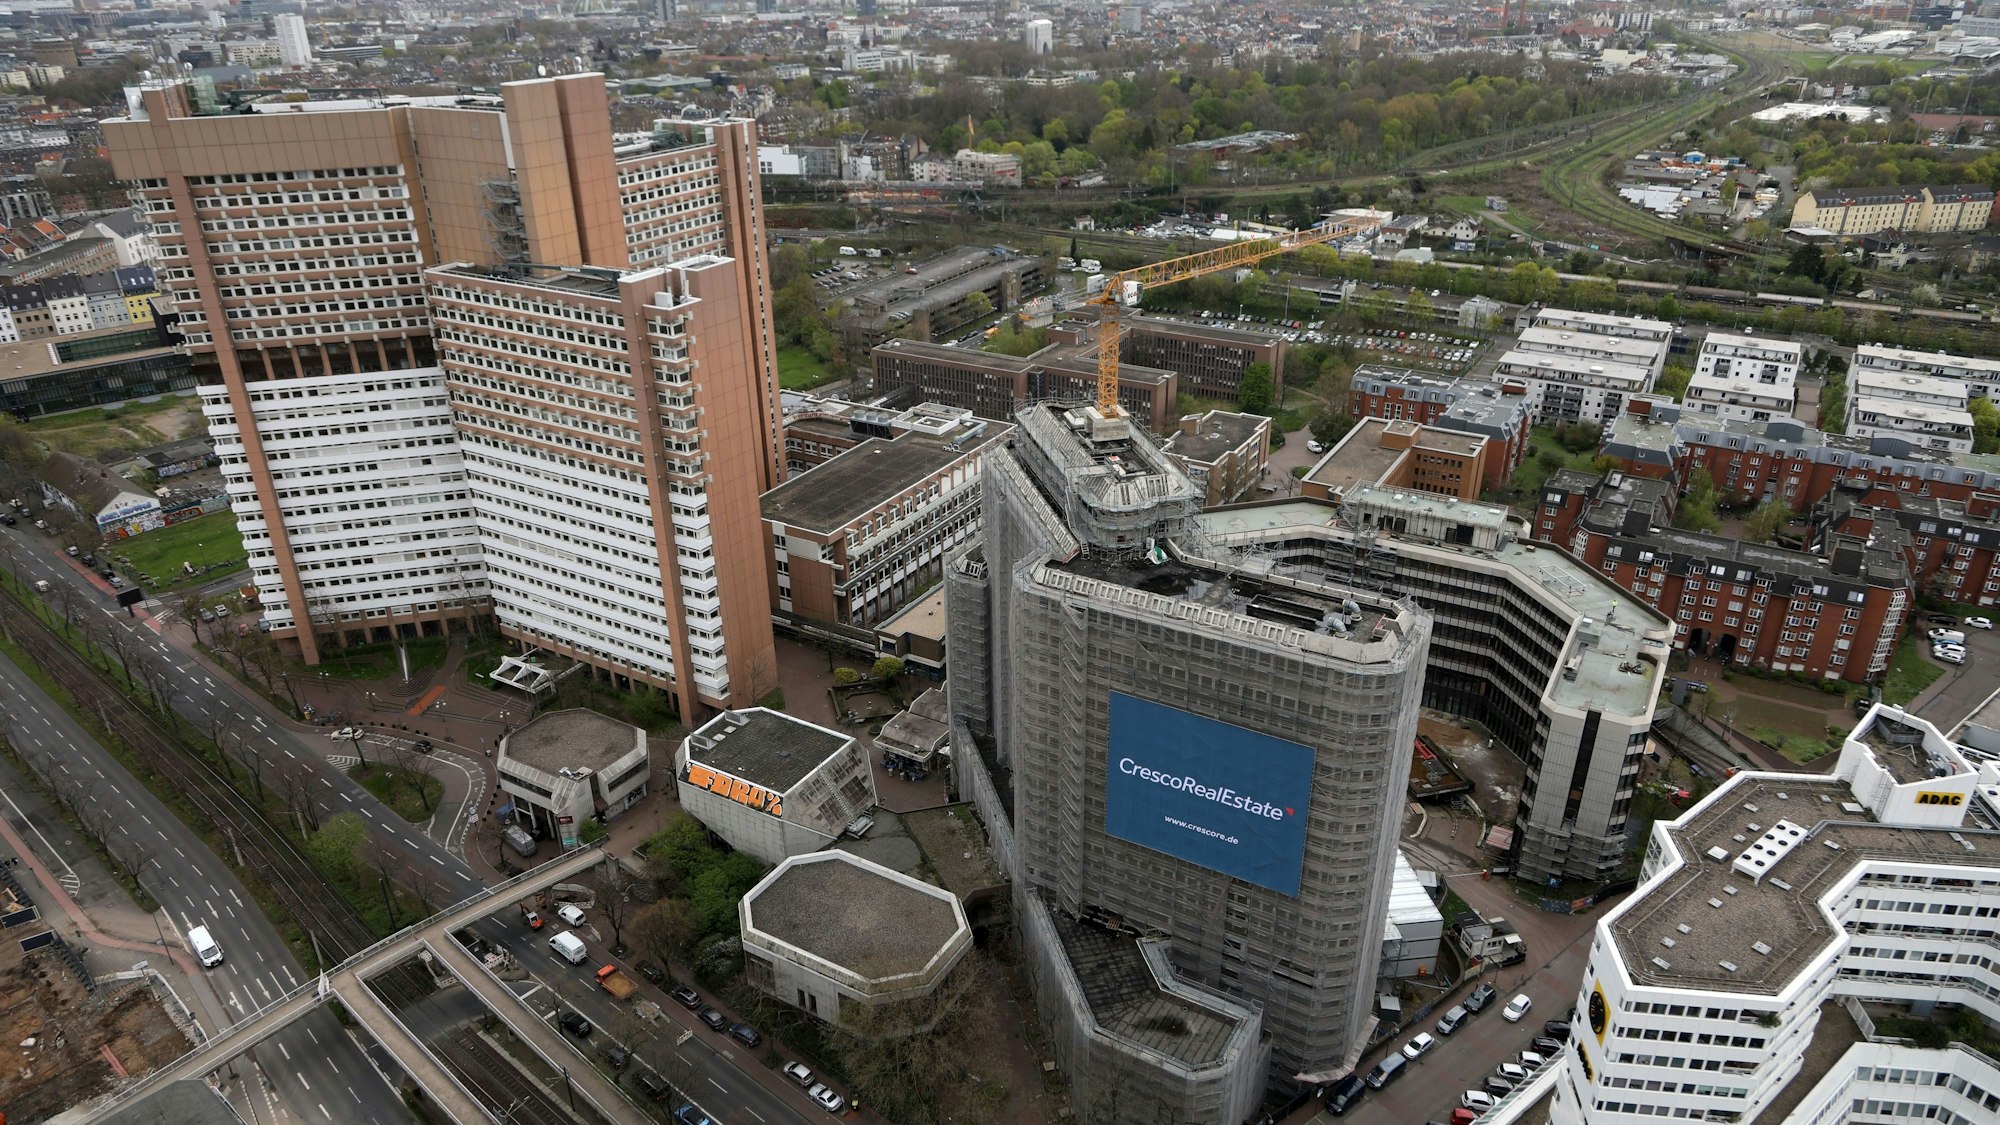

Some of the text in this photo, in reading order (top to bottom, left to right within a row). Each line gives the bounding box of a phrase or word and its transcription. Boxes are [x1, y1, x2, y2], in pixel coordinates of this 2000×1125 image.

[1119, 757, 1284, 821] CrescoRealEstate
[1918, 793, 1962, 806] ADAC
[1164, 816, 1239, 845] www.crescore.de
